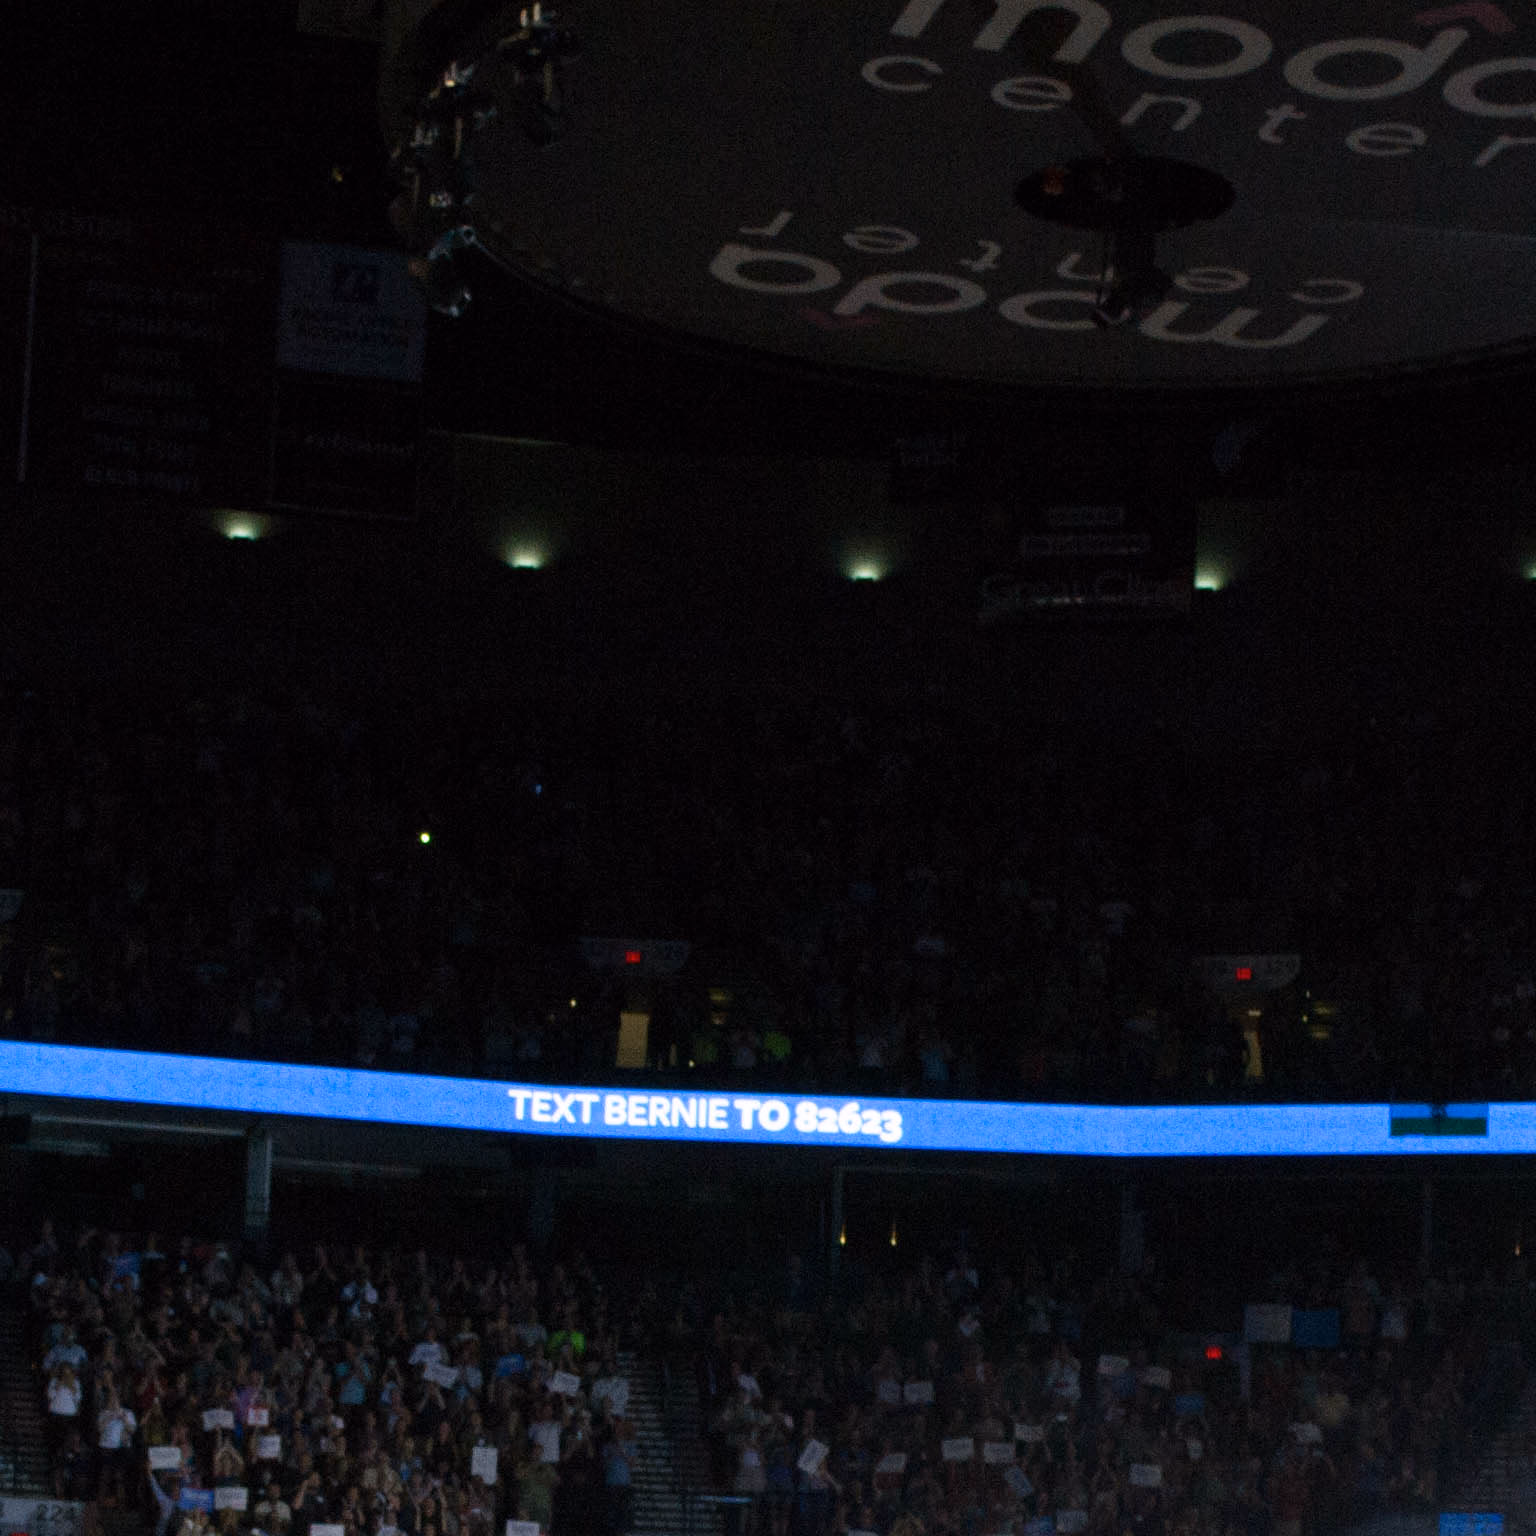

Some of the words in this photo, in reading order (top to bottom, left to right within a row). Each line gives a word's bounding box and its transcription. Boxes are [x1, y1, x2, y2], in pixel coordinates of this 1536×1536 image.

[507, 1088, 601, 1125] TEXT
[603, 1093, 730, 1130] BERNIE
[732, 1097, 791, 1132] TO
[793, 1099, 903, 1143] 82623
